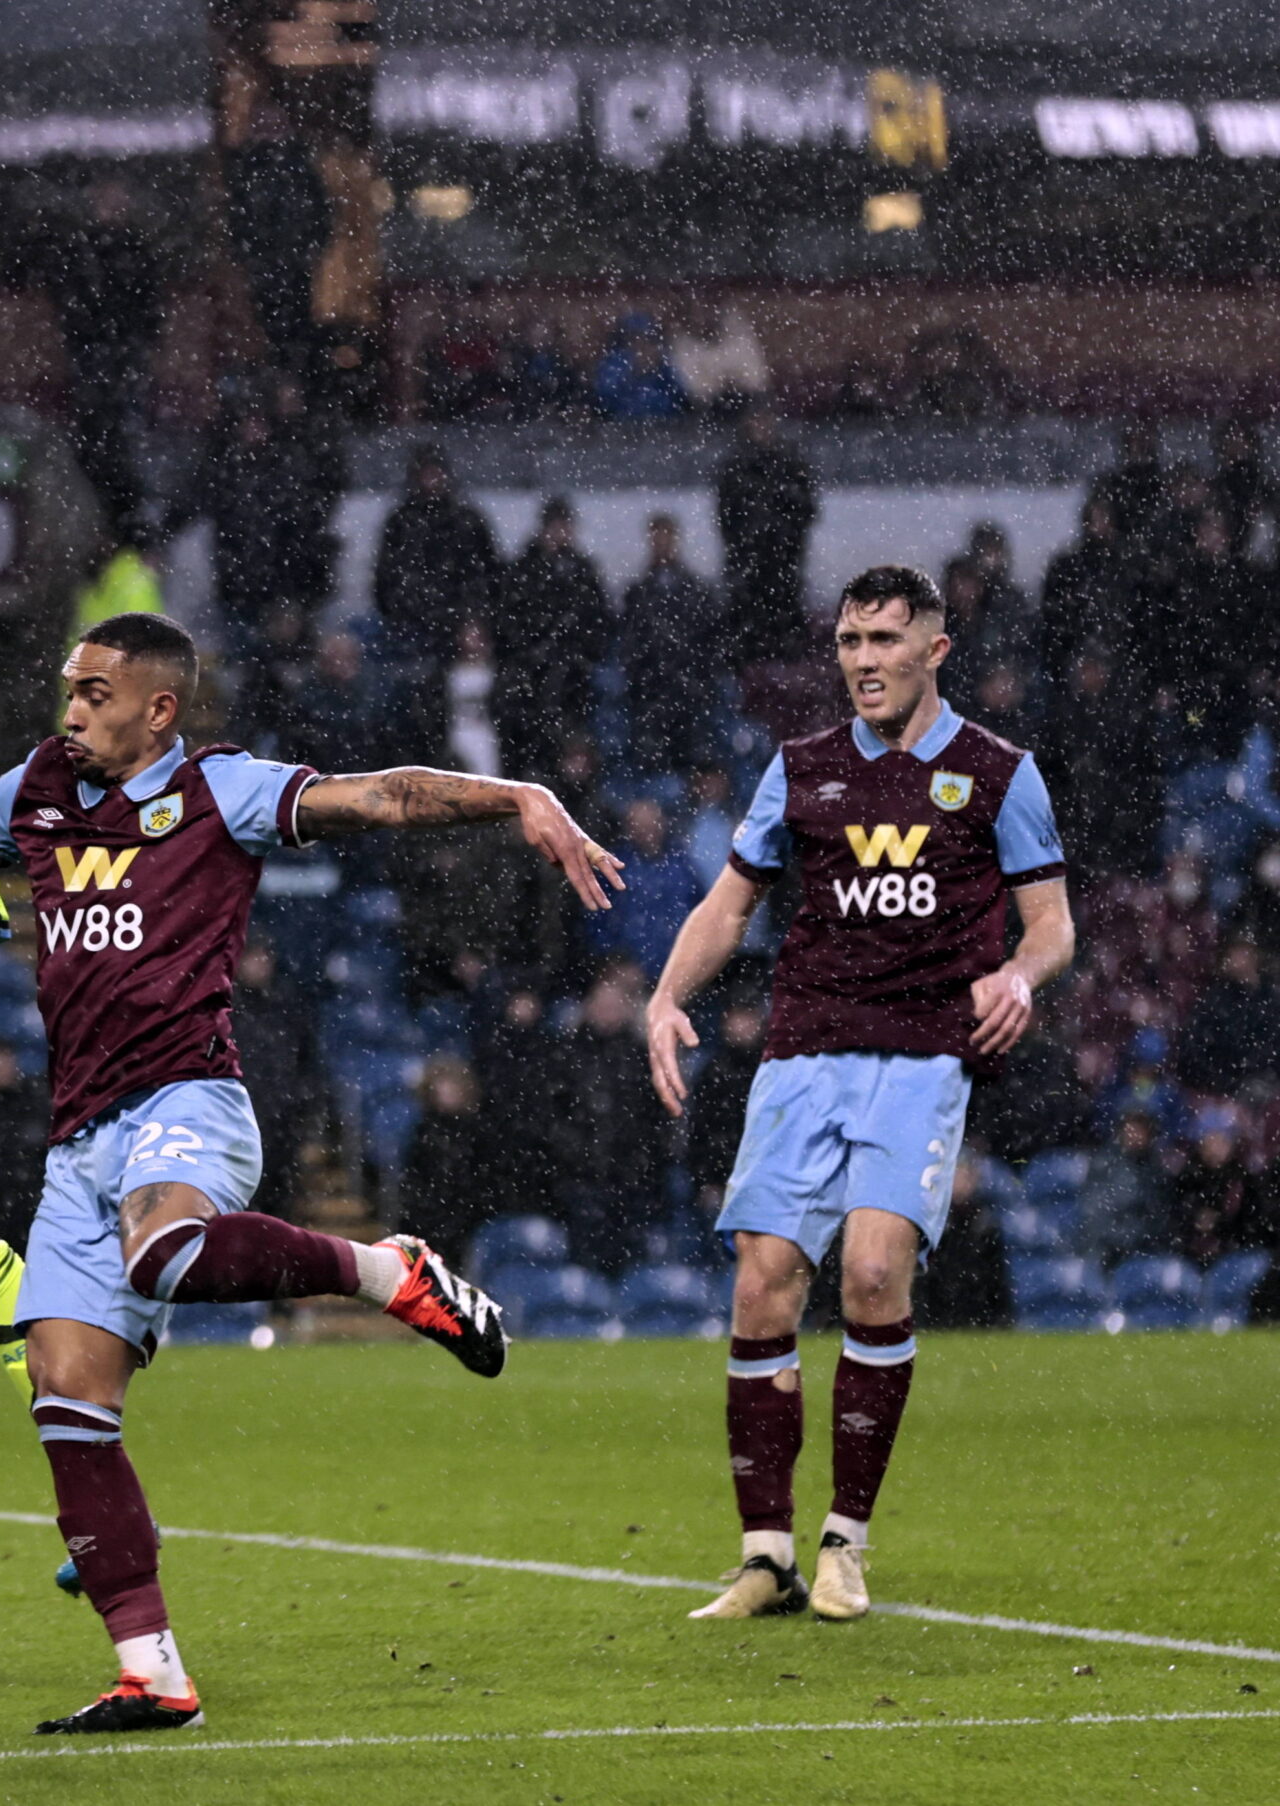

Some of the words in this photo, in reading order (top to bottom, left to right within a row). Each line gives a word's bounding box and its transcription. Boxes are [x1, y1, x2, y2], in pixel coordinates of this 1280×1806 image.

[55, 846, 142, 892] W
[844, 824, 931, 868] W
[833, 872, 937, 917] W88
[40, 903, 144, 955] W88
[127, 1121, 203, 1167] 22
